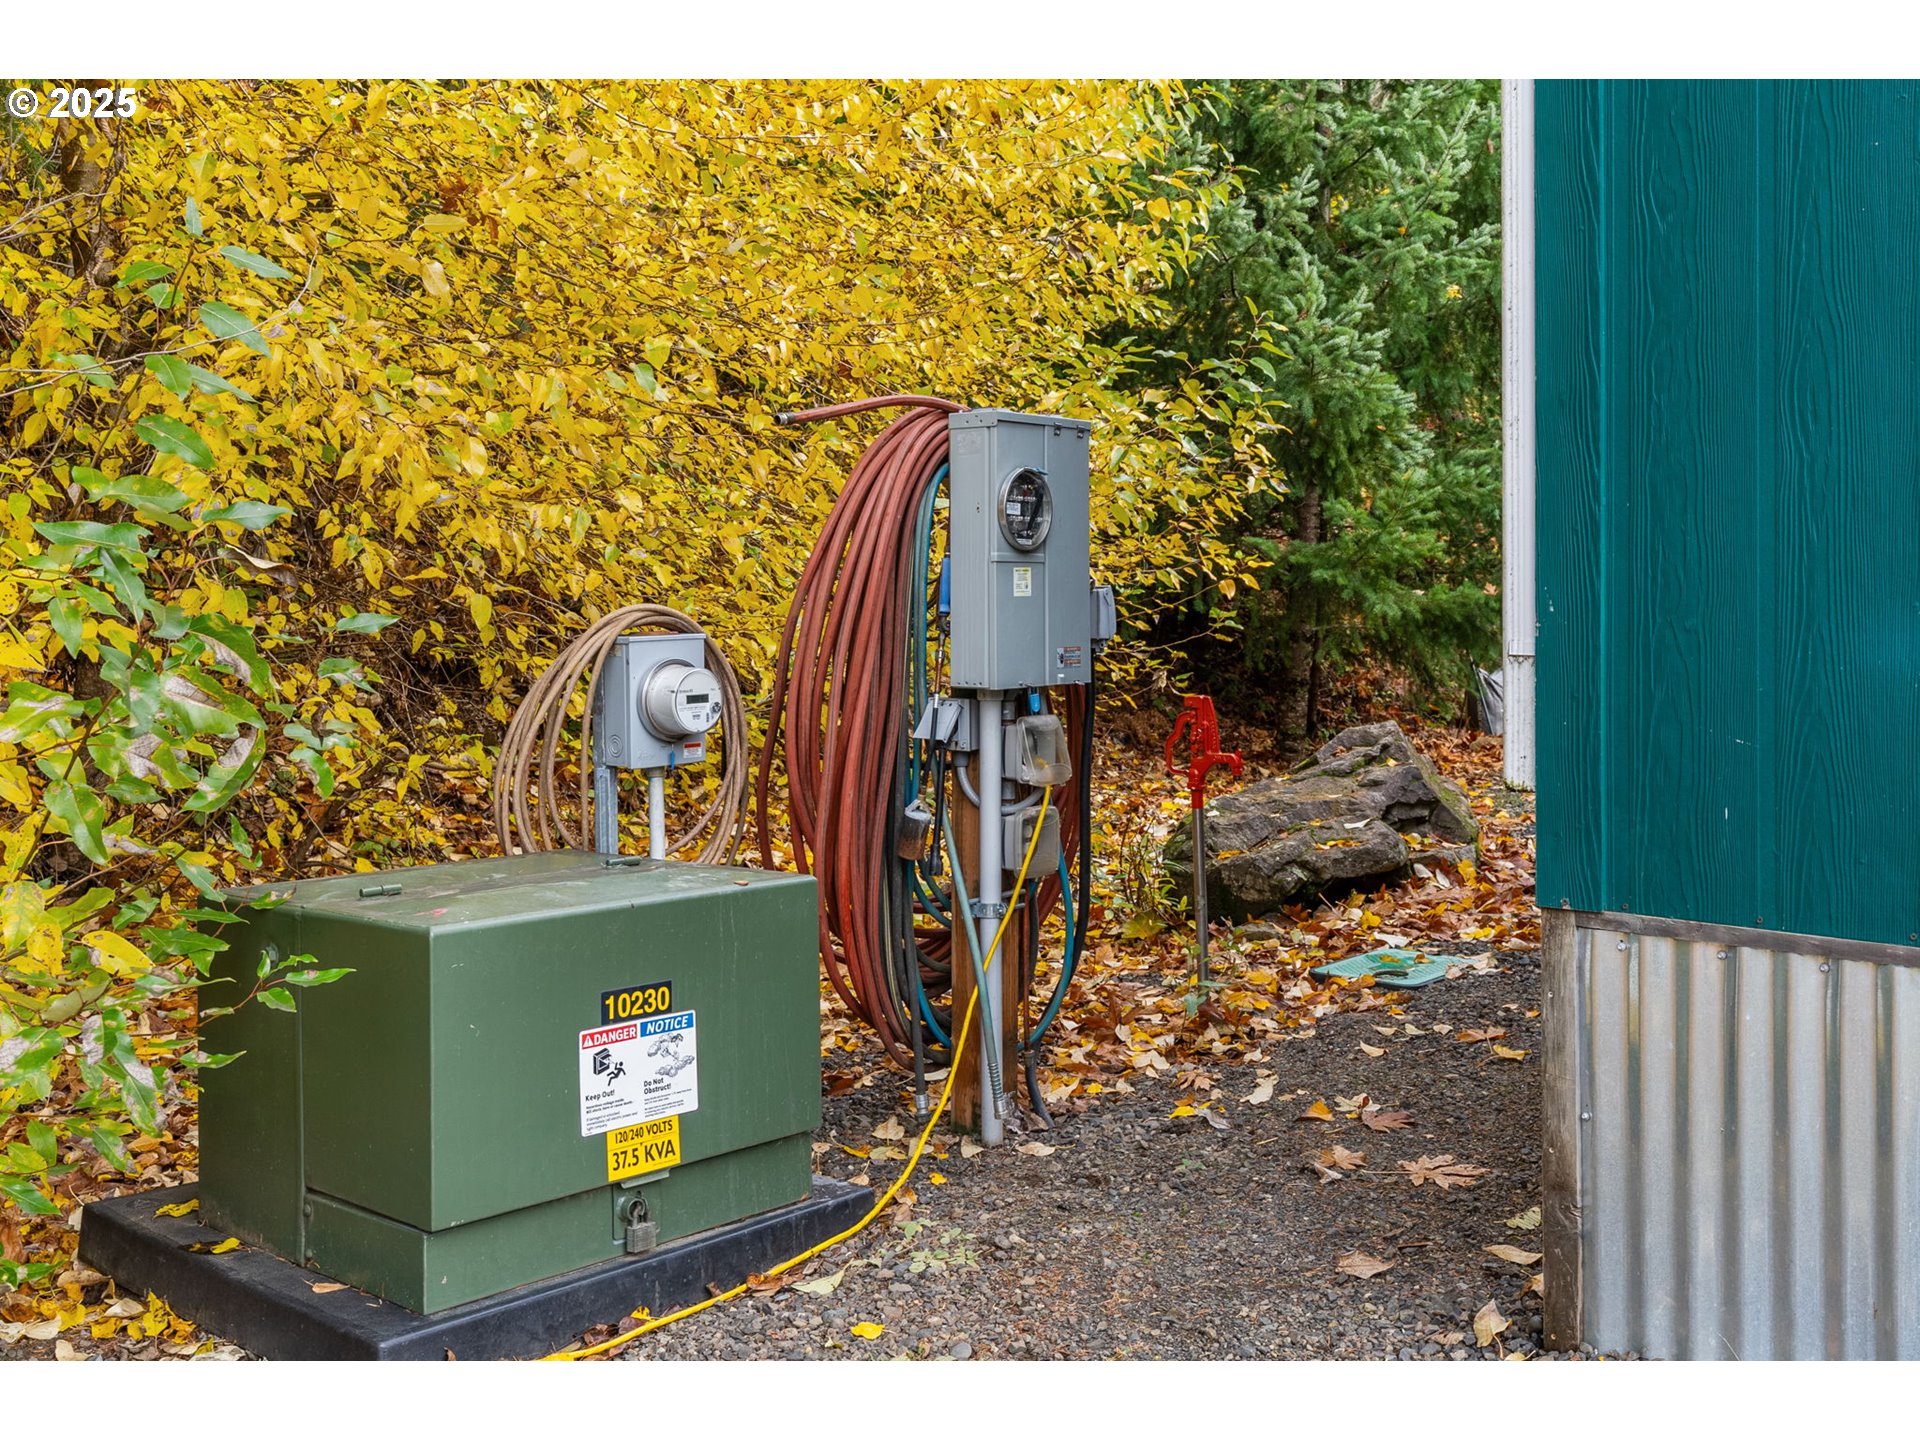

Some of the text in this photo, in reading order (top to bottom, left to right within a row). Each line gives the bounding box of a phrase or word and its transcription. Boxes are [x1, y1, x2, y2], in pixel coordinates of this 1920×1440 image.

[605, 986, 670, 1020] 10230
[646, 1016, 689, 1034] NOTICE
[594, 1027, 637, 1046] DANGER
[644, 1083, 671, 1095] Obstruct!
[653, 1077, 664, 1085] Not
[586, 1089, 615, 1102] Keep Out!
[615, 1127, 644, 1144] 120/240
[645, 1119, 673, 1135] VOLTS
[612, 1139, 676, 1171] 37.5 KVA
